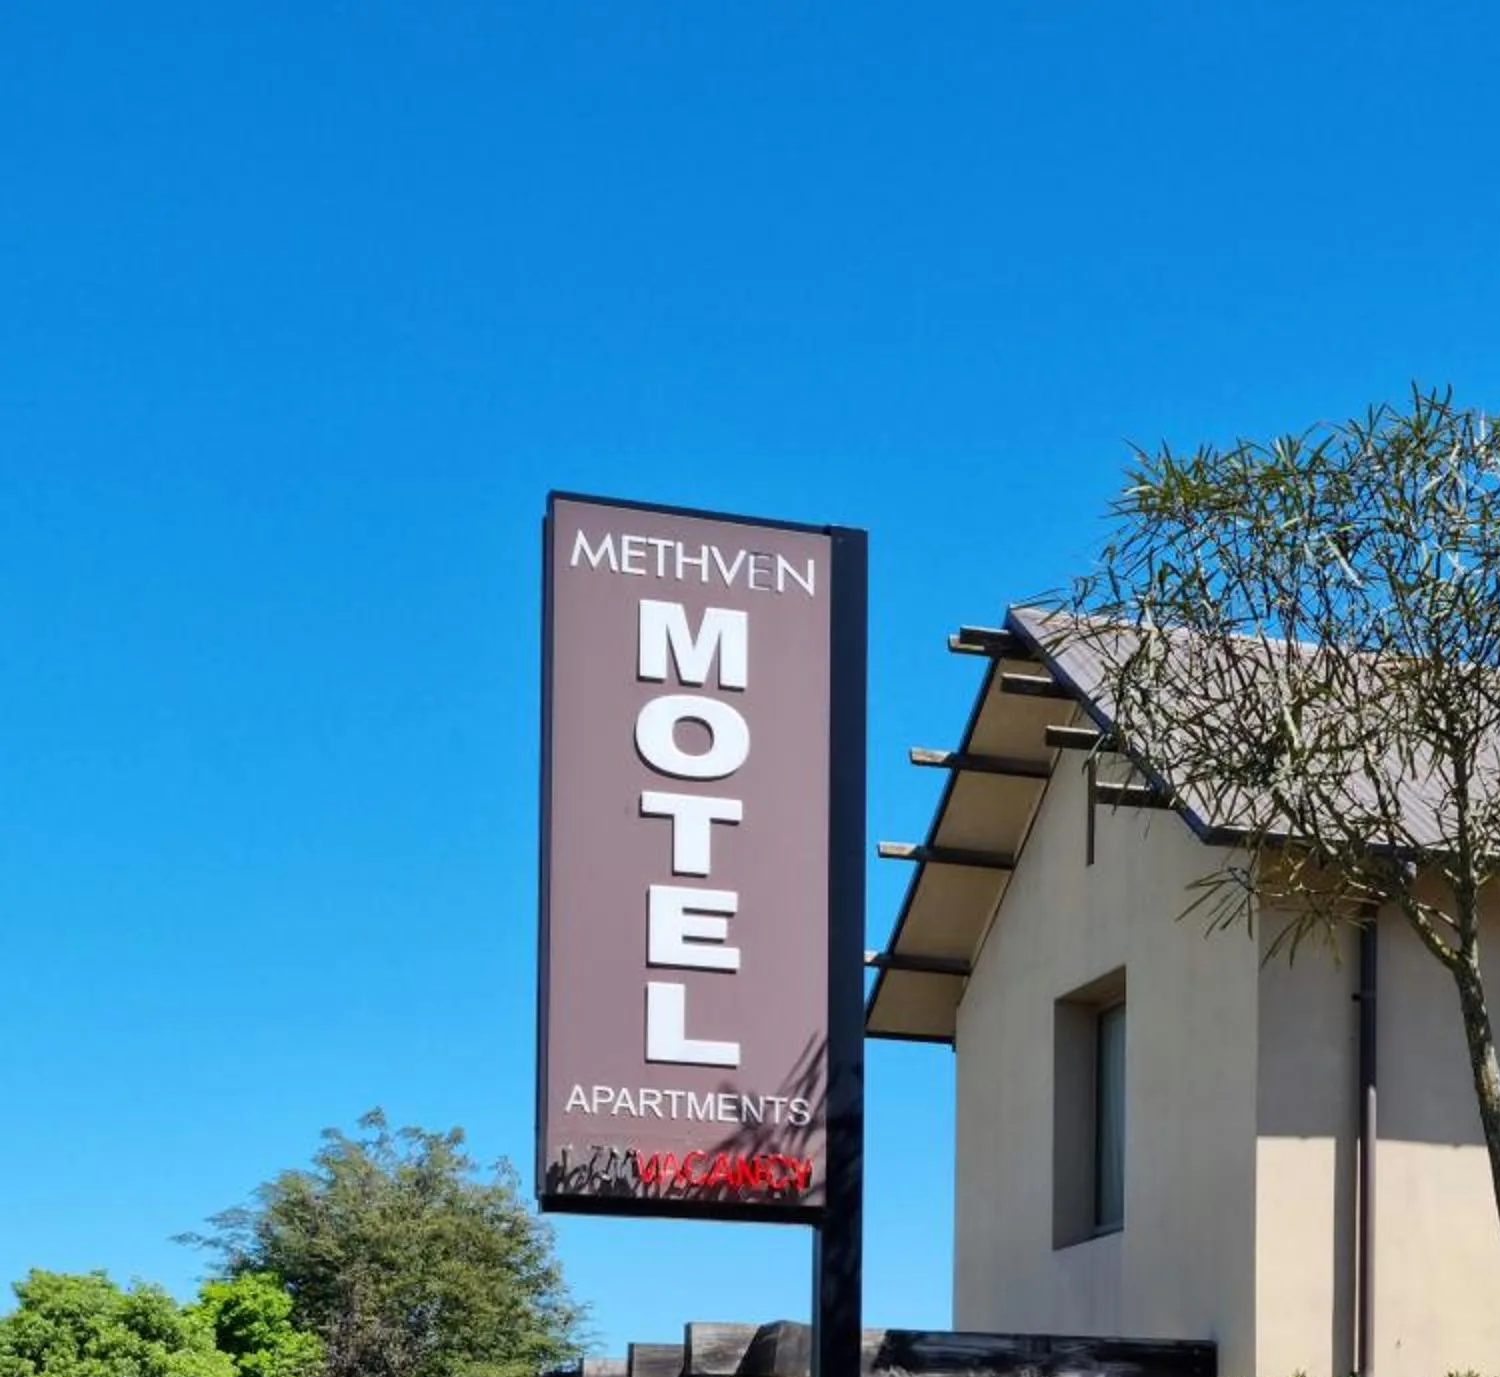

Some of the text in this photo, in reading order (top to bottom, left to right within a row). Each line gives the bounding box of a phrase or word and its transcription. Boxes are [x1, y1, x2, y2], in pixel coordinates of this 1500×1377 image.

[570, 529, 815, 597] METHVEN
[635, 599, 750, 1066] MOTEL
[565, 1084, 810, 1127] APARTMENTS
